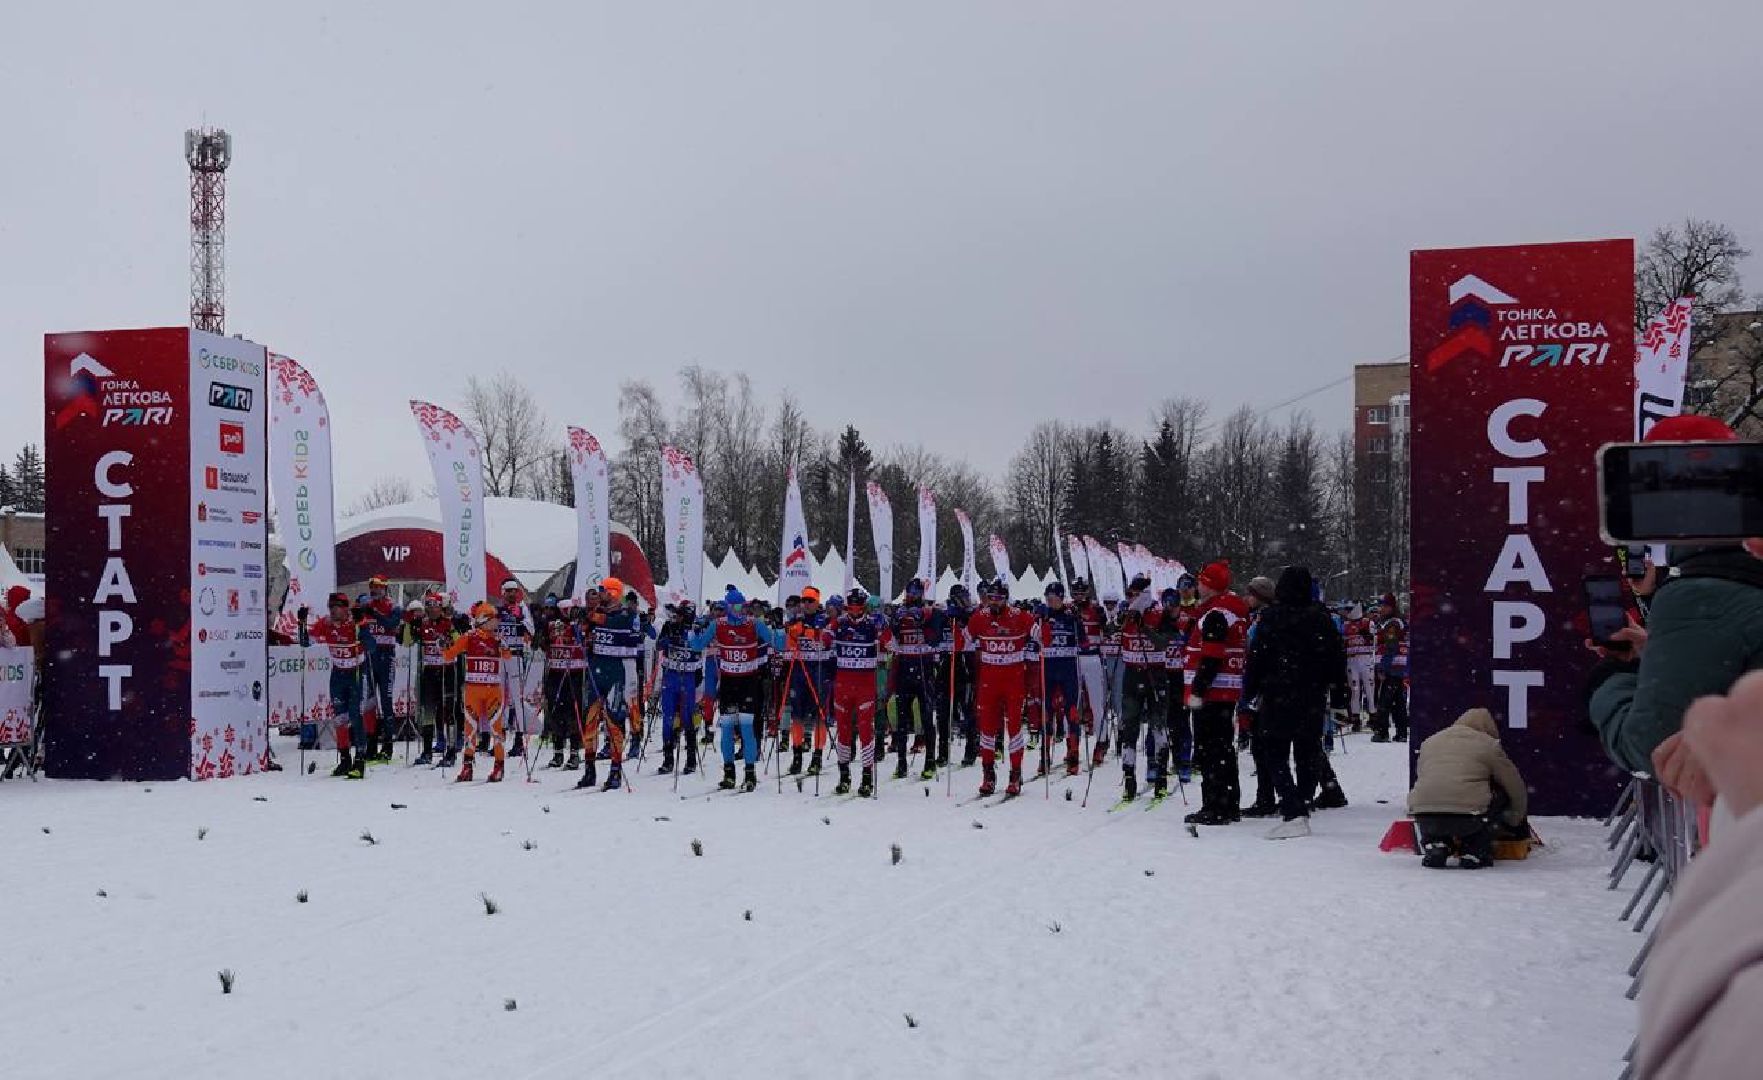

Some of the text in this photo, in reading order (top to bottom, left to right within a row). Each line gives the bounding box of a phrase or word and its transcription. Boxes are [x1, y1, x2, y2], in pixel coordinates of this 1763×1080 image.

[1499, 322, 1609, 341] ЛЕГКОВА
[103, 391, 173, 406] ЛЕГКОВА
[381, 546, 411, 562] VIP
[1483, 398, 1554, 729] СТАРТ
[92, 450, 137, 710] СТАРТ
